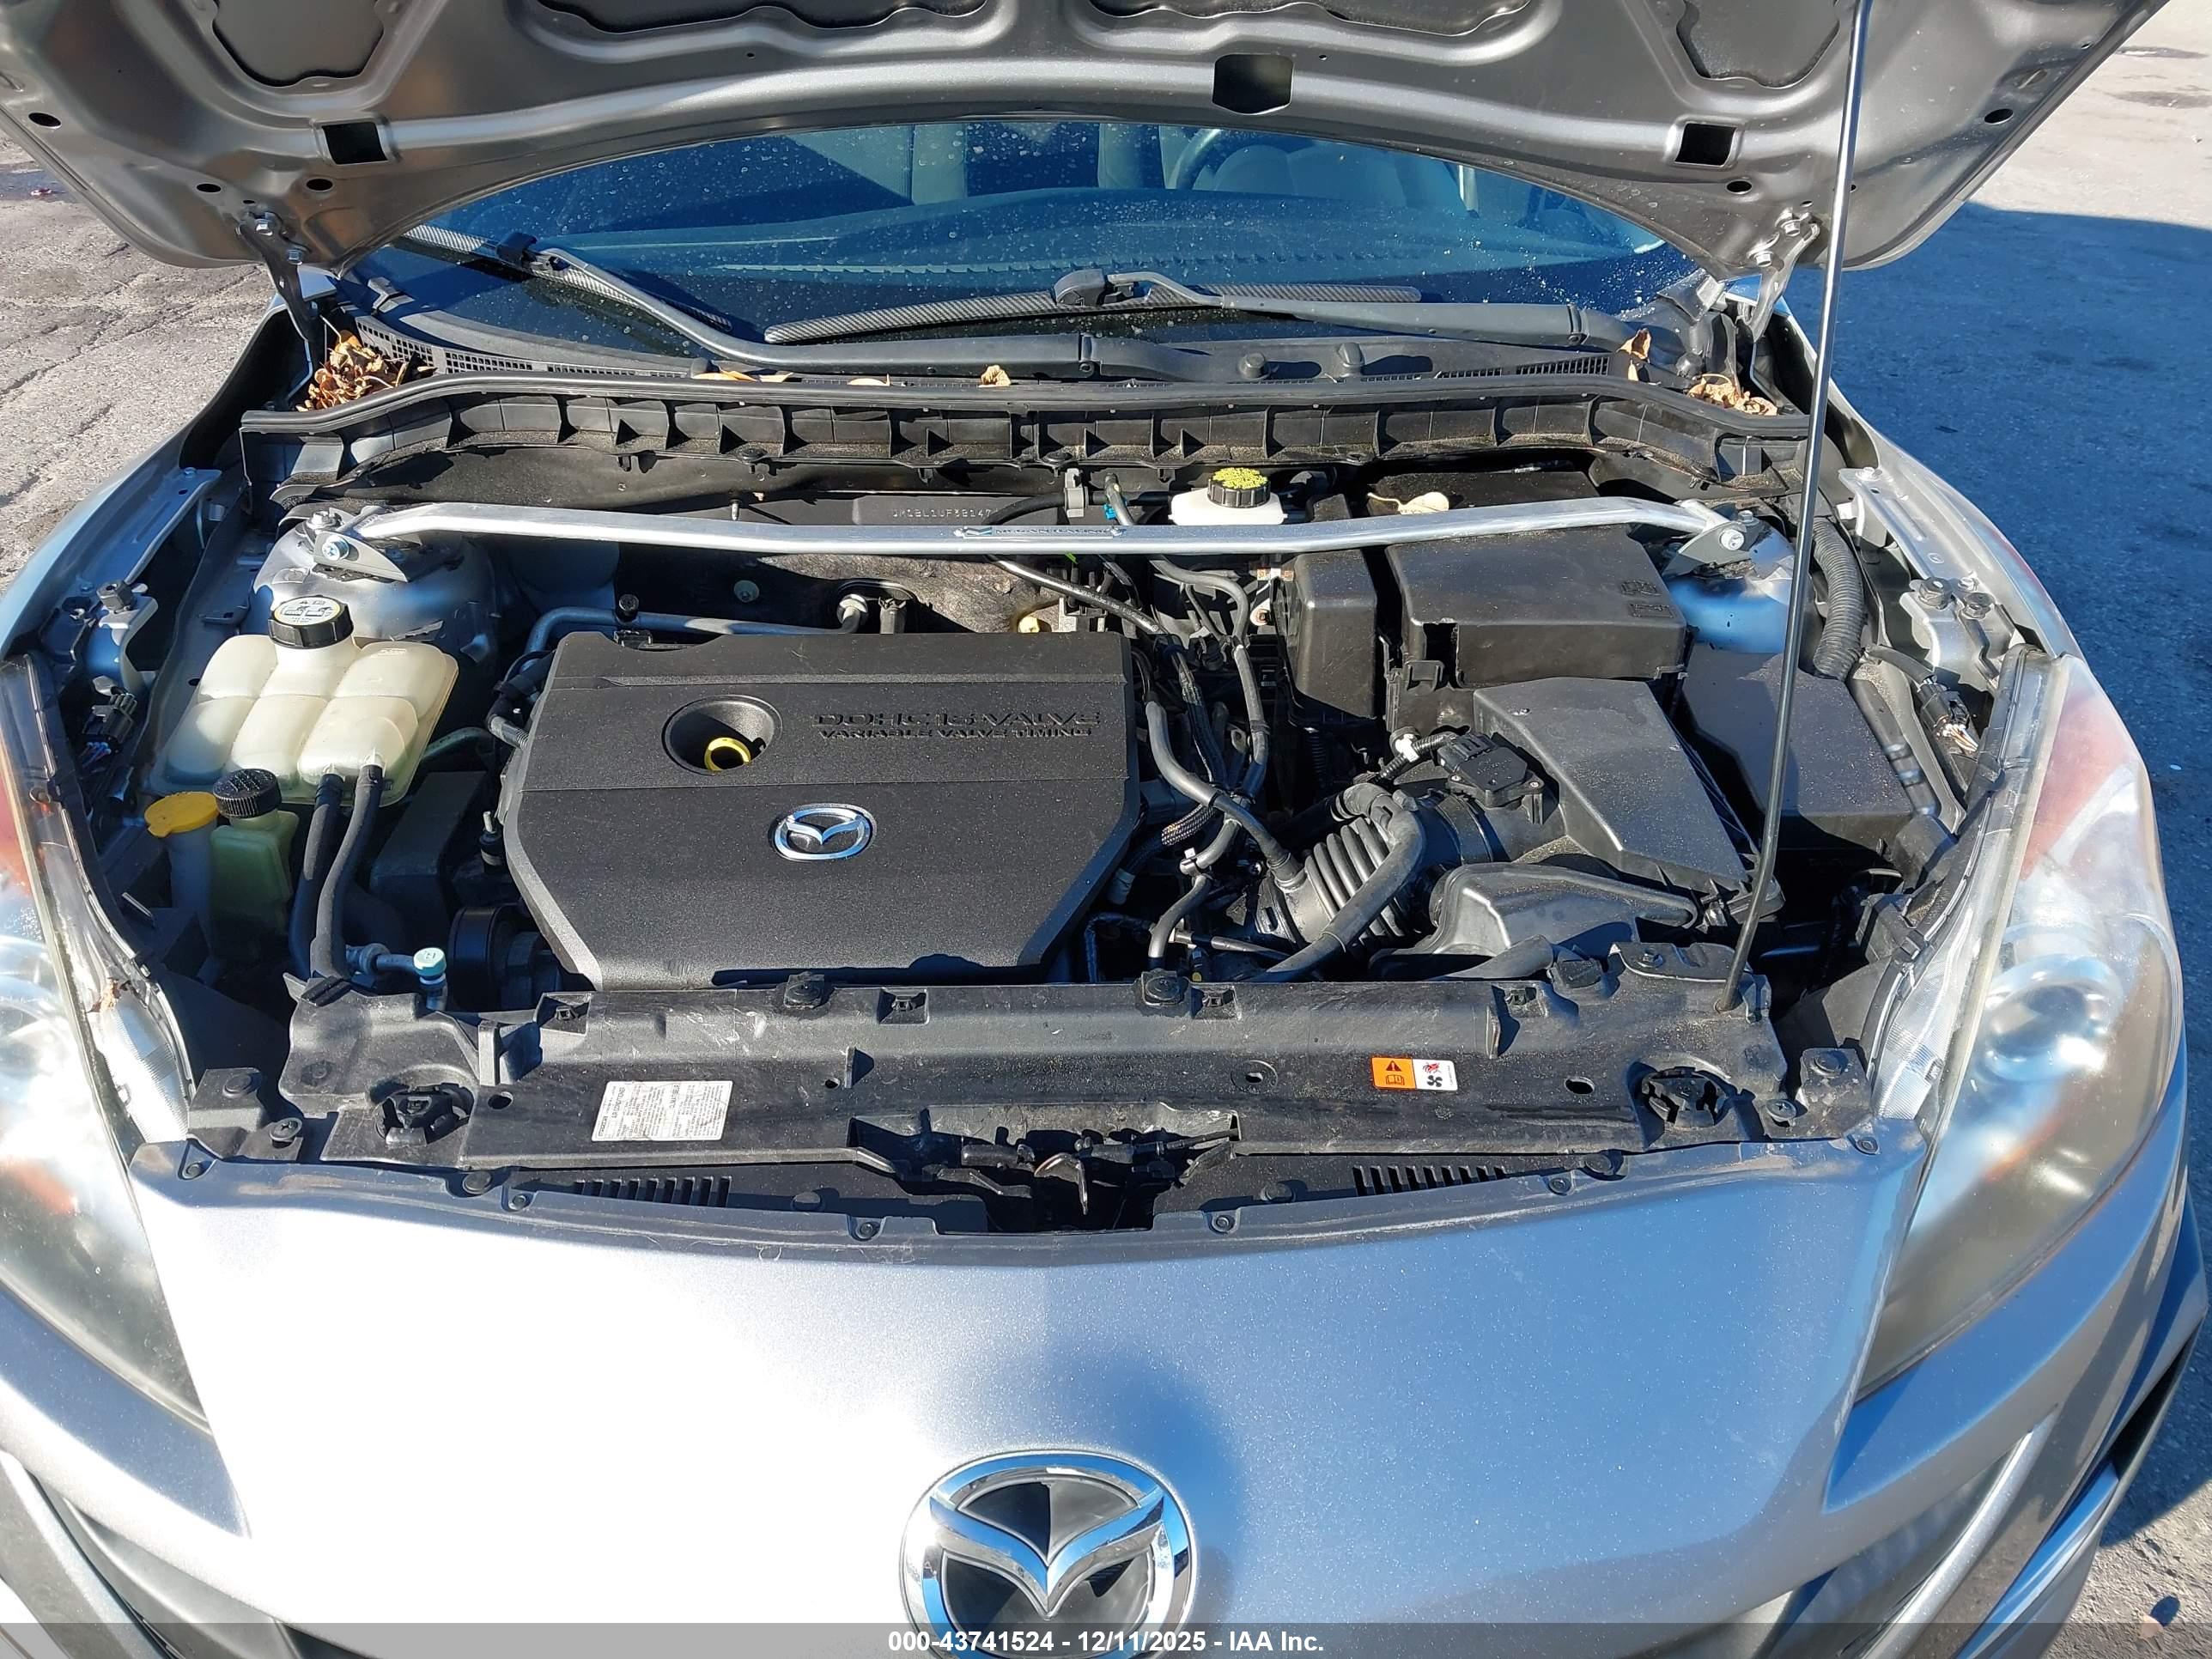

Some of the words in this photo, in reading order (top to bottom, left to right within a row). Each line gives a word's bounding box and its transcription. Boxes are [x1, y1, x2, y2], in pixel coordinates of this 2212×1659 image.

[813, 712, 930, 727] DOHC
[935, 712, 976, 726] 16
[981, 711, 1100, 726] VALVE
[818, 728, 933, 739] VARIABLE
[936, 728, 1007, 738] VALVE
[1011, 727, 1092, 737] TIMING
